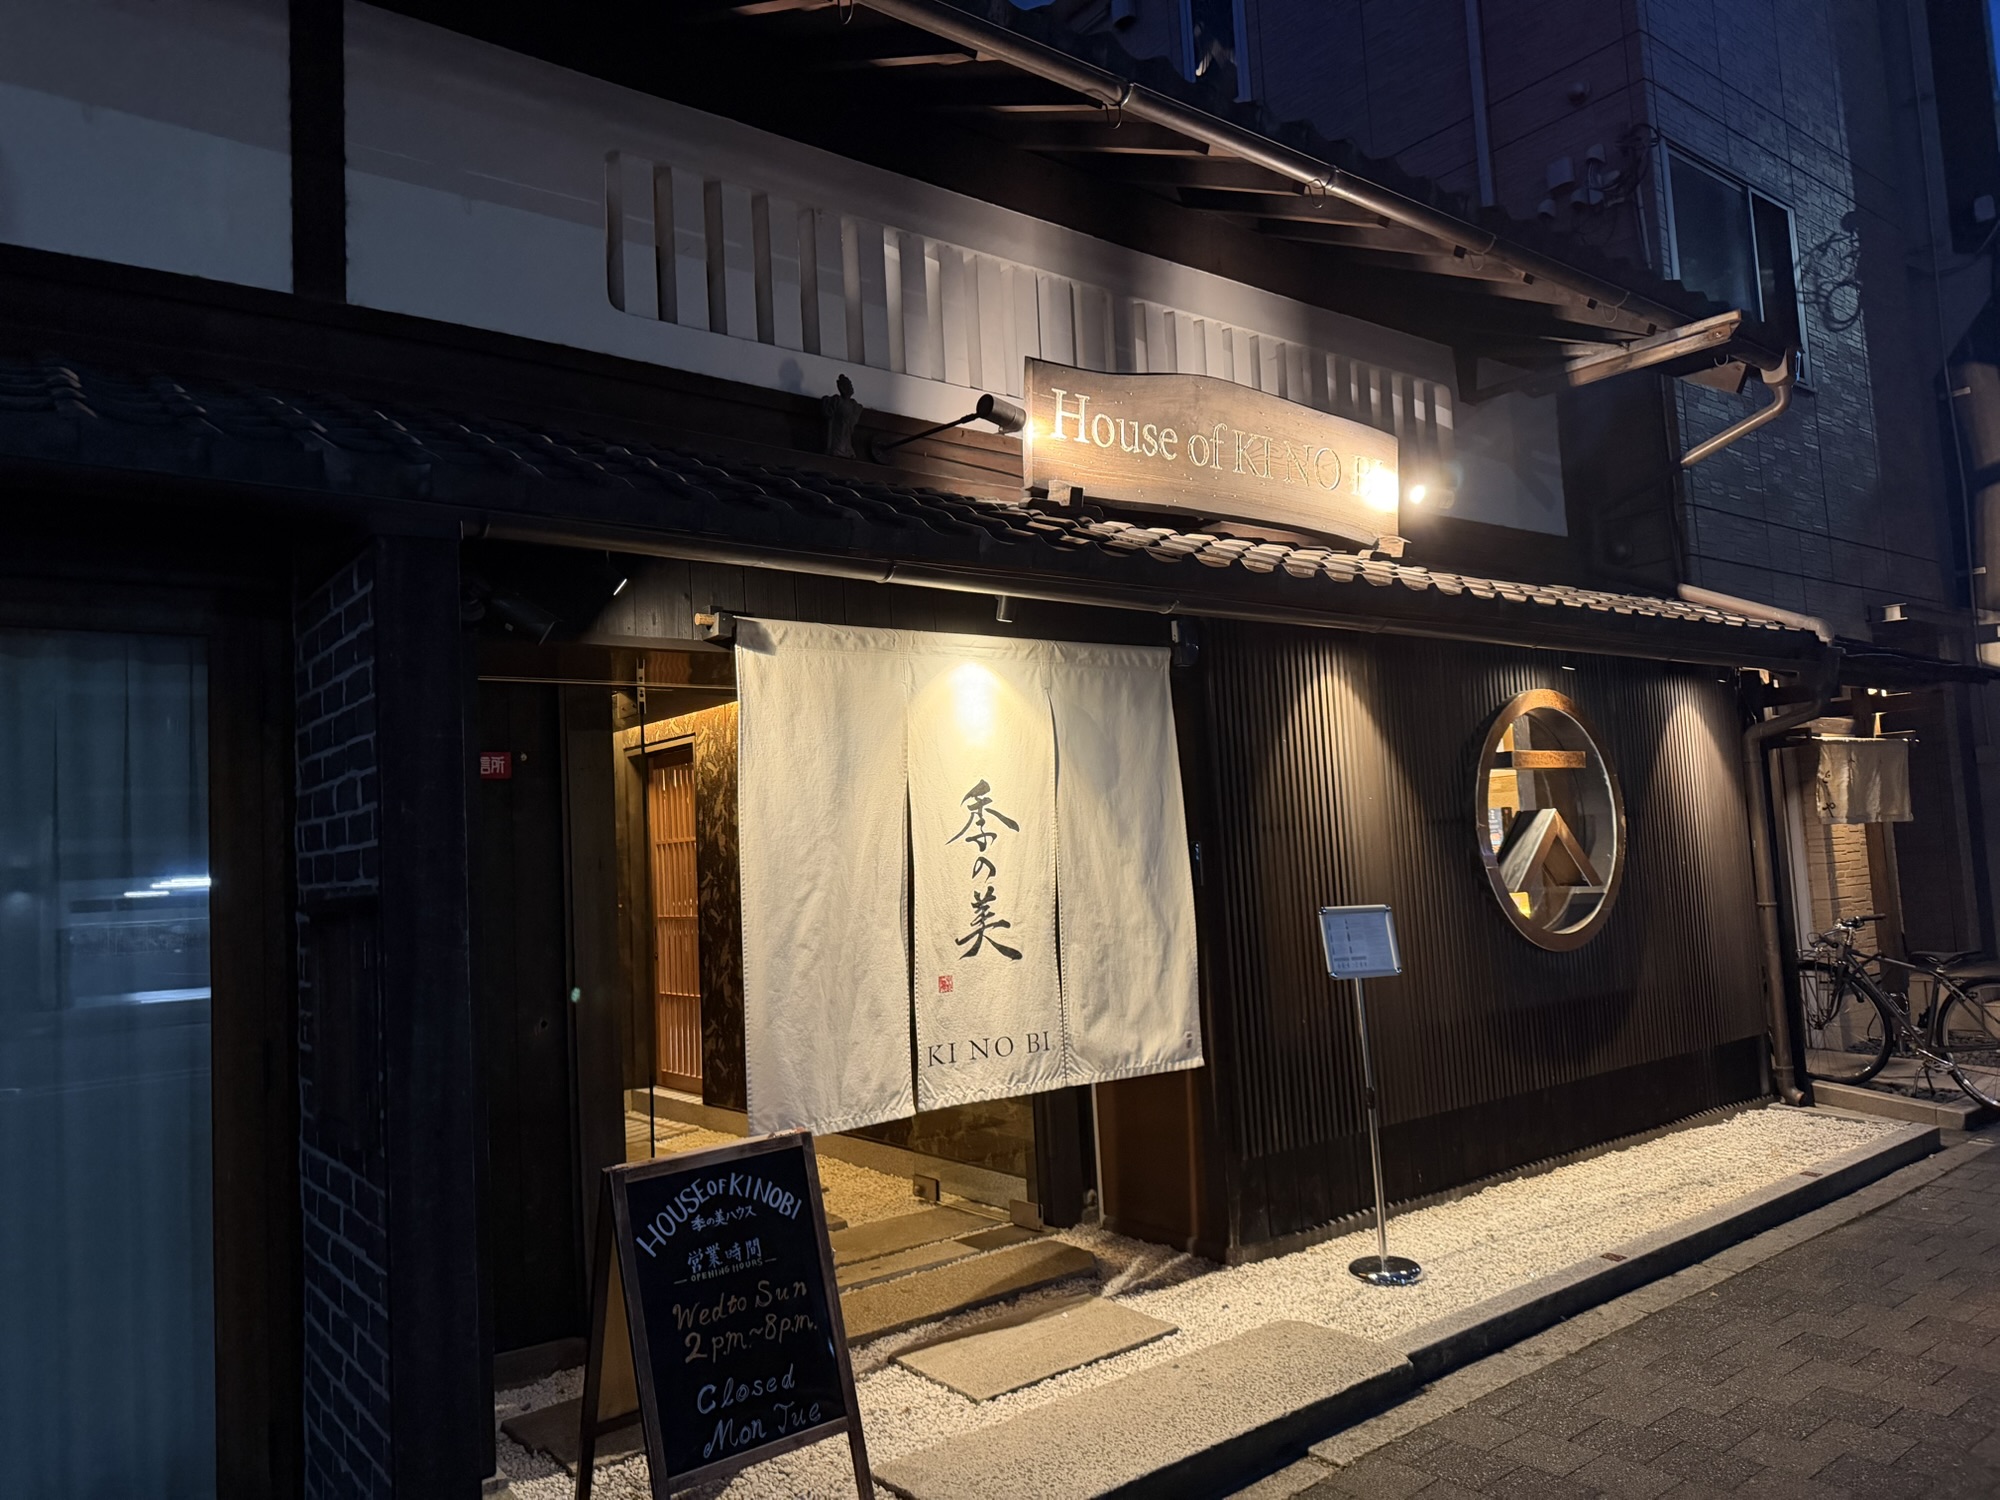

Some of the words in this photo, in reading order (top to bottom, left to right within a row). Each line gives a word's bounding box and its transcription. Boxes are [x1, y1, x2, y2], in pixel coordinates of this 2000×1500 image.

[1050, 387, 1179, 462] House
[1186, 422, 1229, 471] of
[1231, 429, 1275, 481] KI
[1282, 440, 1343, 492] NO
[945, 778, 1023, 961] 季の美
[927, 1042, 957, 1068] KI
[968, 1035, 1014, 1061] NO
[1025, 1030, 1051, 1054] BI
[635, 1178, 711, 1259] HOUSE
[691, 1205, 757, 1232] 季の美ハウス
[687, 1237, 763, 1274] 営業時間
[690, 1264, 730, 1283] OPENING
[732, 1257, 763, 1273] HOURS
[672, 1292, 727, 1331] Wed
[755, 1280, 807, 1308] Sun
[697, 1363, 795, 1415] Closed
[703, 1418, 767, 1459] Mon
[773, 1401, 821, 1434] Tue
